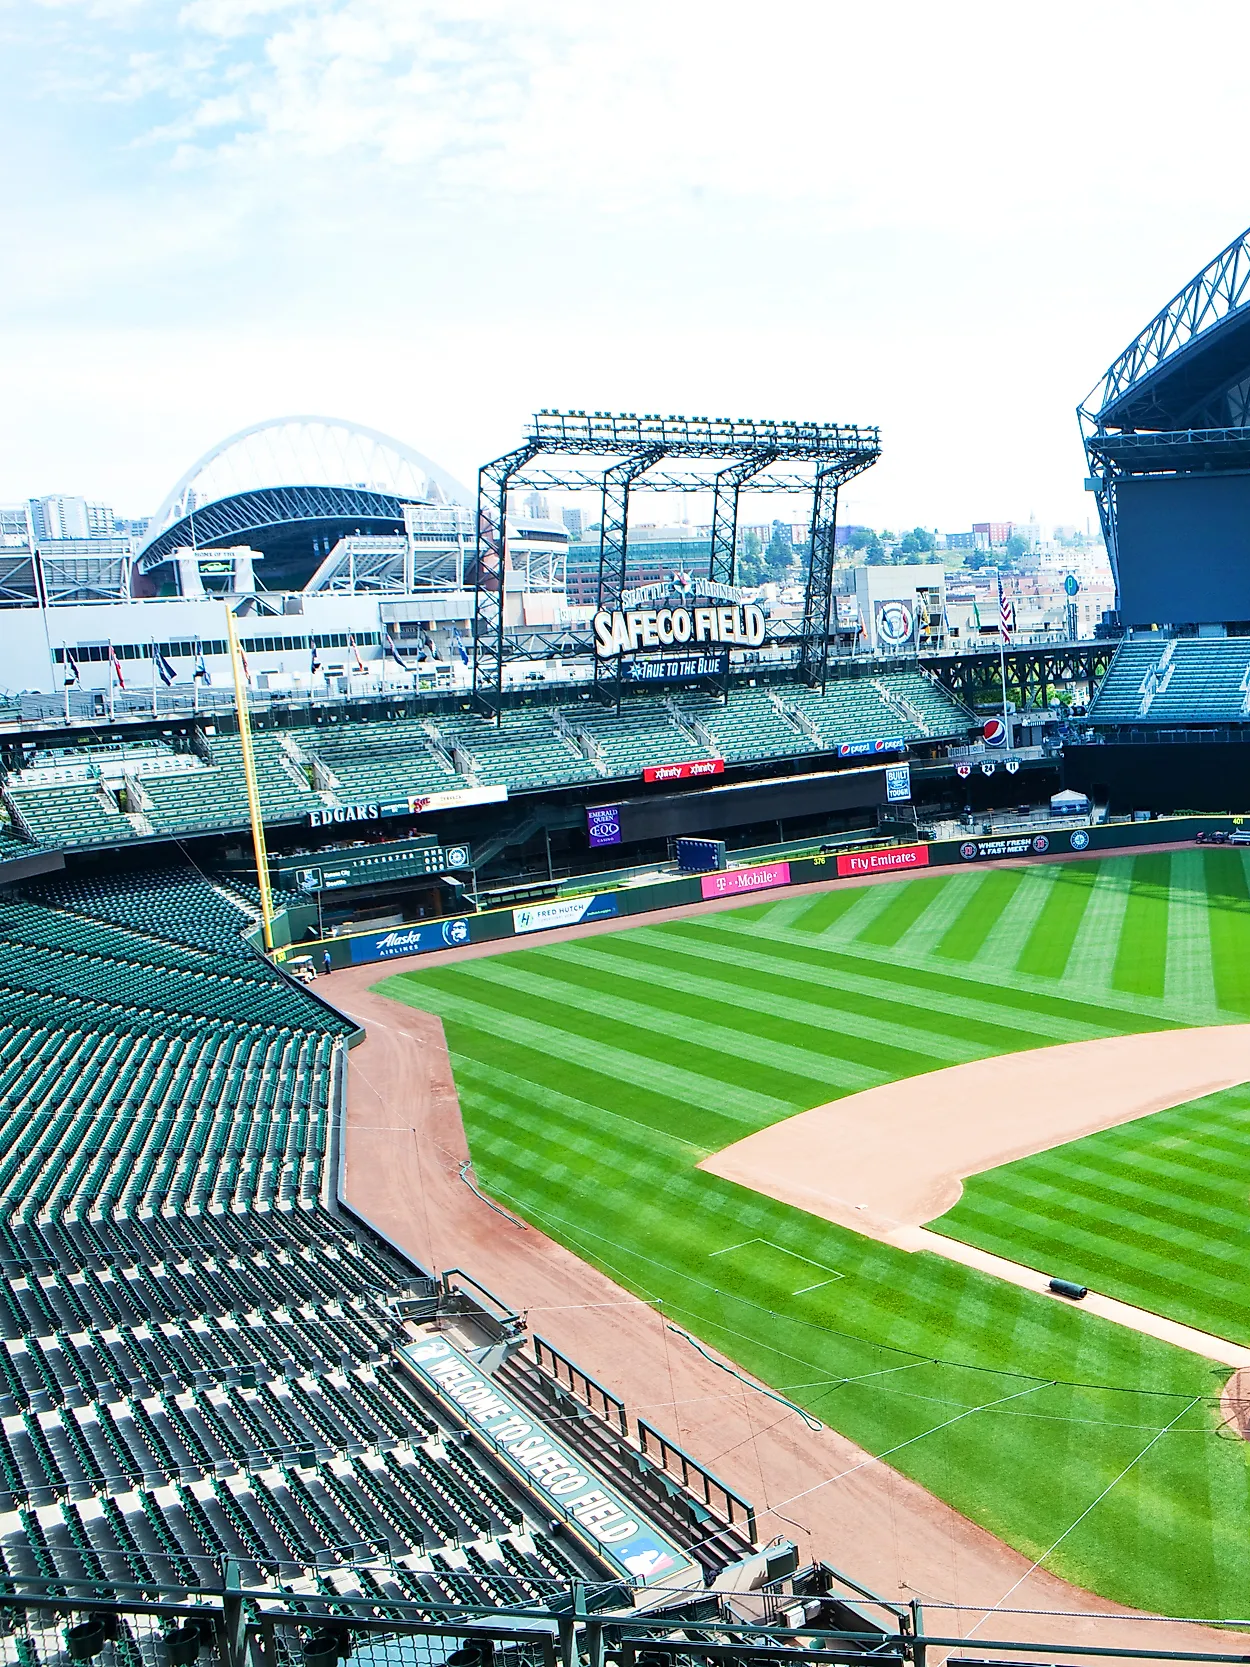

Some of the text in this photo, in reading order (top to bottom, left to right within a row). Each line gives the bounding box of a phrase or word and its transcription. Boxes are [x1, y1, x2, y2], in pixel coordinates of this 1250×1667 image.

[621, 578, 742, 607] SEATTLE MARINERS
[594, 604, 766, 658] SAFECO FIELD
[642, 657, 721, 679] TRUE TO THE BLUE
[851, 739, 904, 754] pepsi pepsi
[655, 762, 716, 780] xfinity xfinity
[960, 766, 968, 774] 42
[984, 764, 993, 772] 24
[1010, 762, 1016, 770] 11
[888, 770, 907, 781] BUILT
[890, 788, 908, 797] TOUGH
[310, 804, 378, 827] EDGARS
[588, 809, 618, 818] EMERALD
[594, 815, 614, 824] QUEEN
[978, 841, 1006, 850] WHERE
[1006, 838, 1032, 847] FRESH
[988, 846, 1006, 855] FAST
[814, 858, 826, 866] 376
[850, 852, 917, 870] Fly Emirates
[538, 909, 556, 918] FRED
[560, 904, 584, 914] HUTCH
[376, 930, 422, 949] Alaska
[380, 944, 419, 956] AIRLINES
[427, 1356, 640, 1544] WELCOME TO SAFECO FIELD
